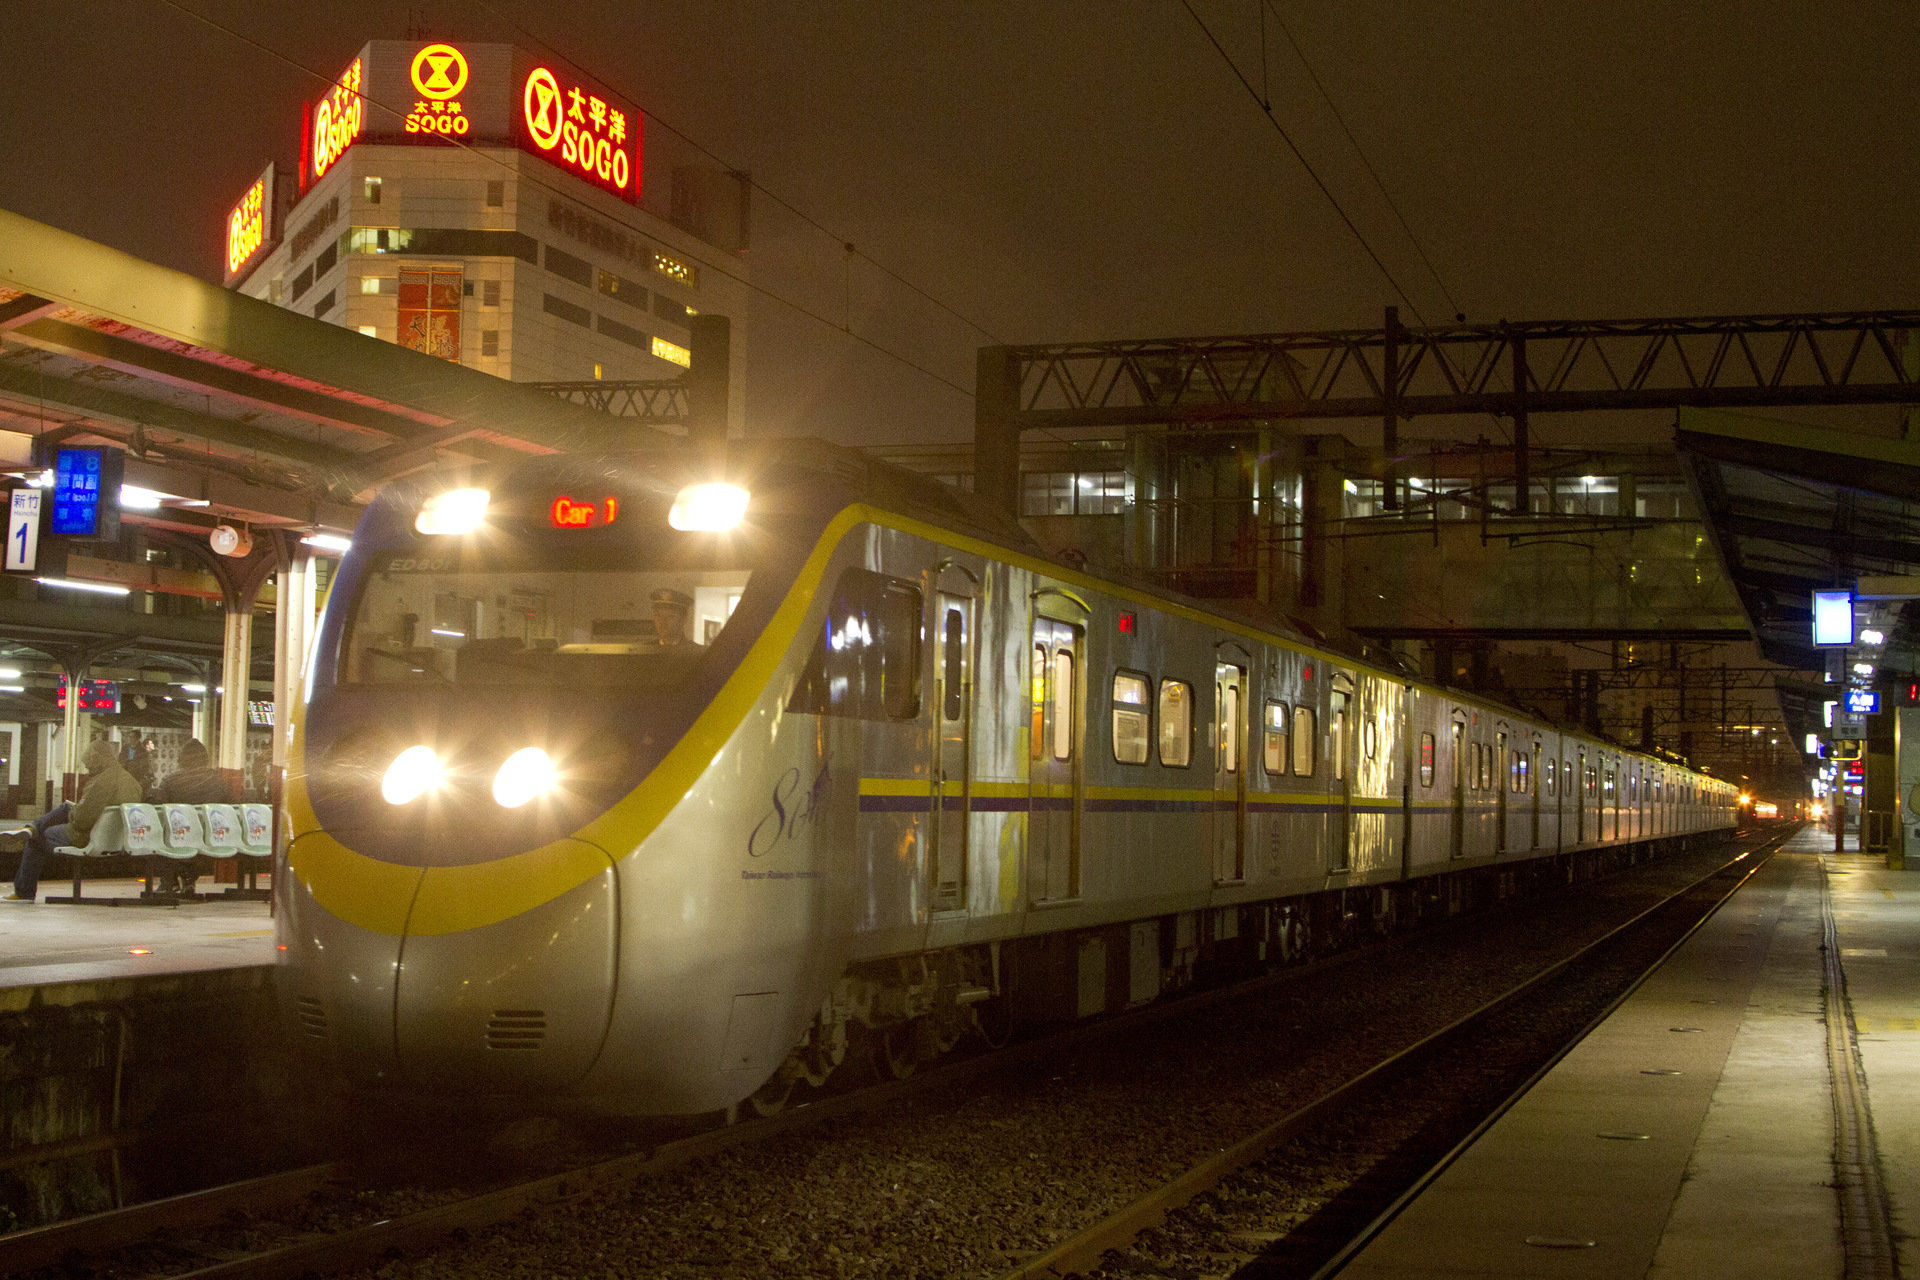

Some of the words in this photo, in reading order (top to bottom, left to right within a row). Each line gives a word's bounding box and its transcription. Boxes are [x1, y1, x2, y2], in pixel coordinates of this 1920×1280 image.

[405, 114, 469, 135] SOGO
[413, 101, 462, 115] 太平洋
[567, 86, 627, 145] 太平洋
[328, 96, 362, 164] SOGO
[562, 119, 630, 189] SOGO
[239, 211, 264, 263] SOGO
[13, 494, 39, 509] 新竹
[554, 498, 595, 526] Car
[604, 497, 617, 524] 1
[16, 522, 28, 564] 1
